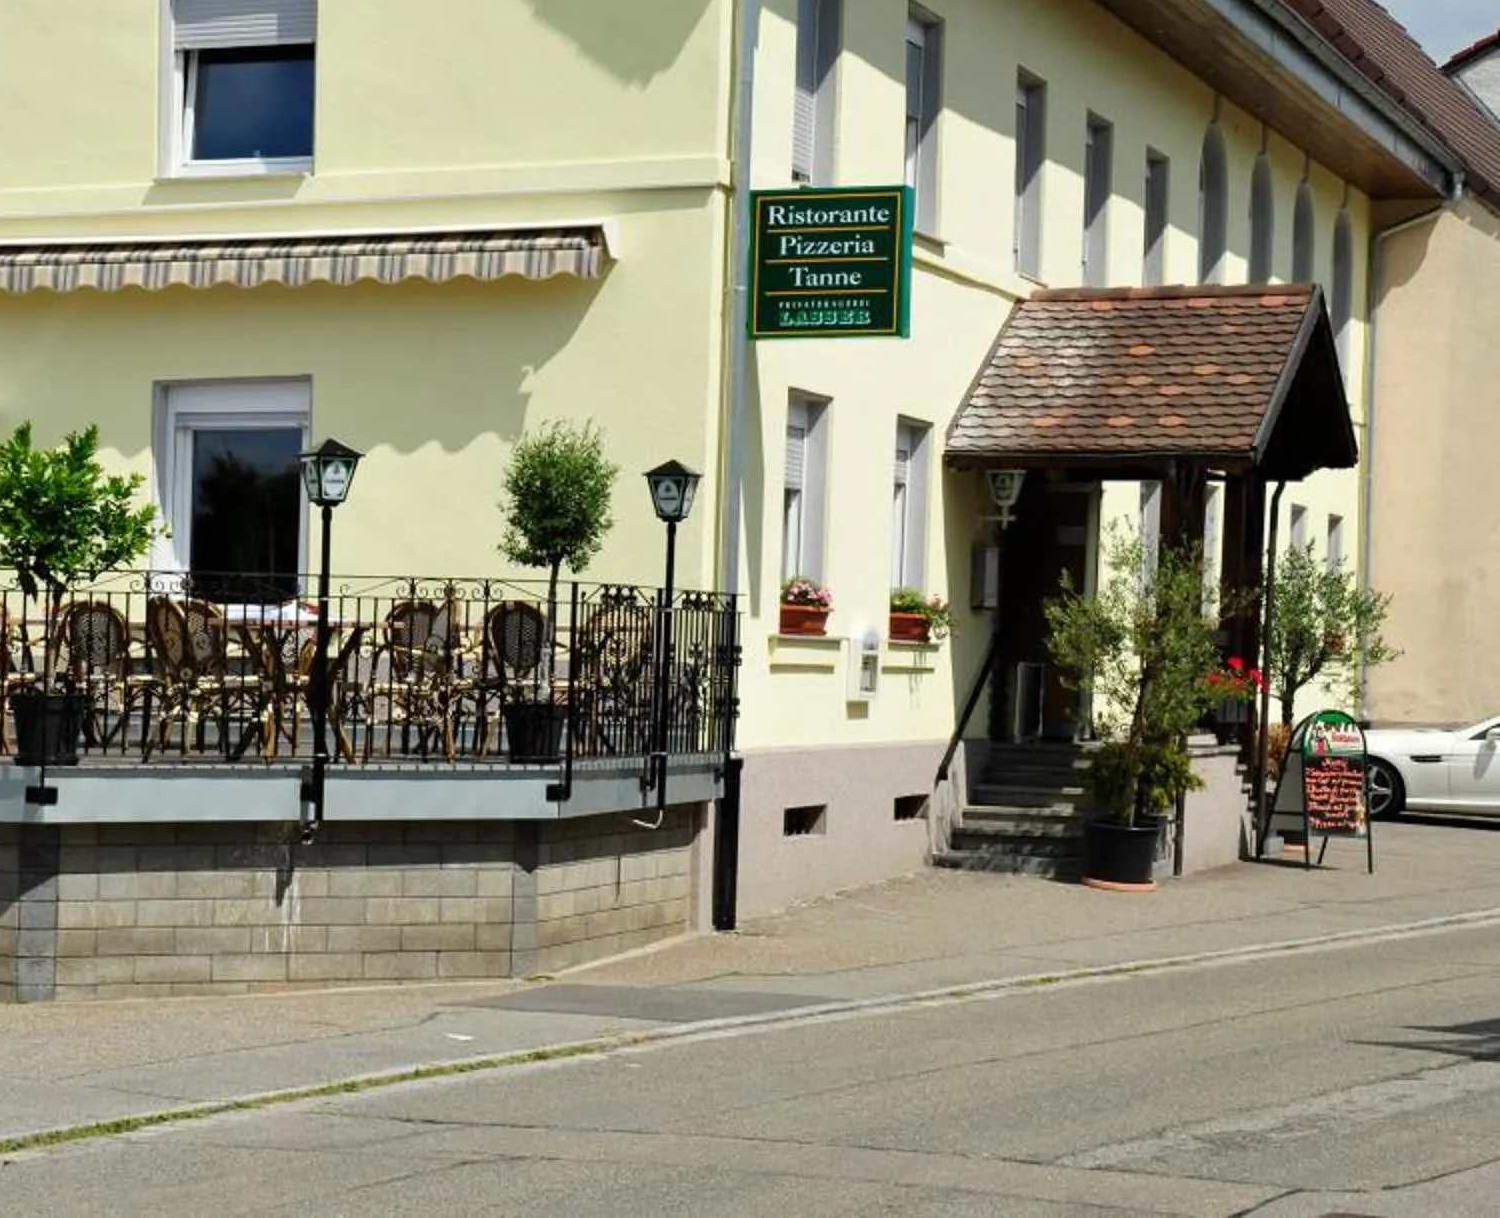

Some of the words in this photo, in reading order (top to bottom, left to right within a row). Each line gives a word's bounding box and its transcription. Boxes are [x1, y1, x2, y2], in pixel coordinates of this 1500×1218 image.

[767, 205, 890, 225] Ristorante
[779, 233, 876, 256] Pizzeria
[788, 266, 862, 287] Tanne
